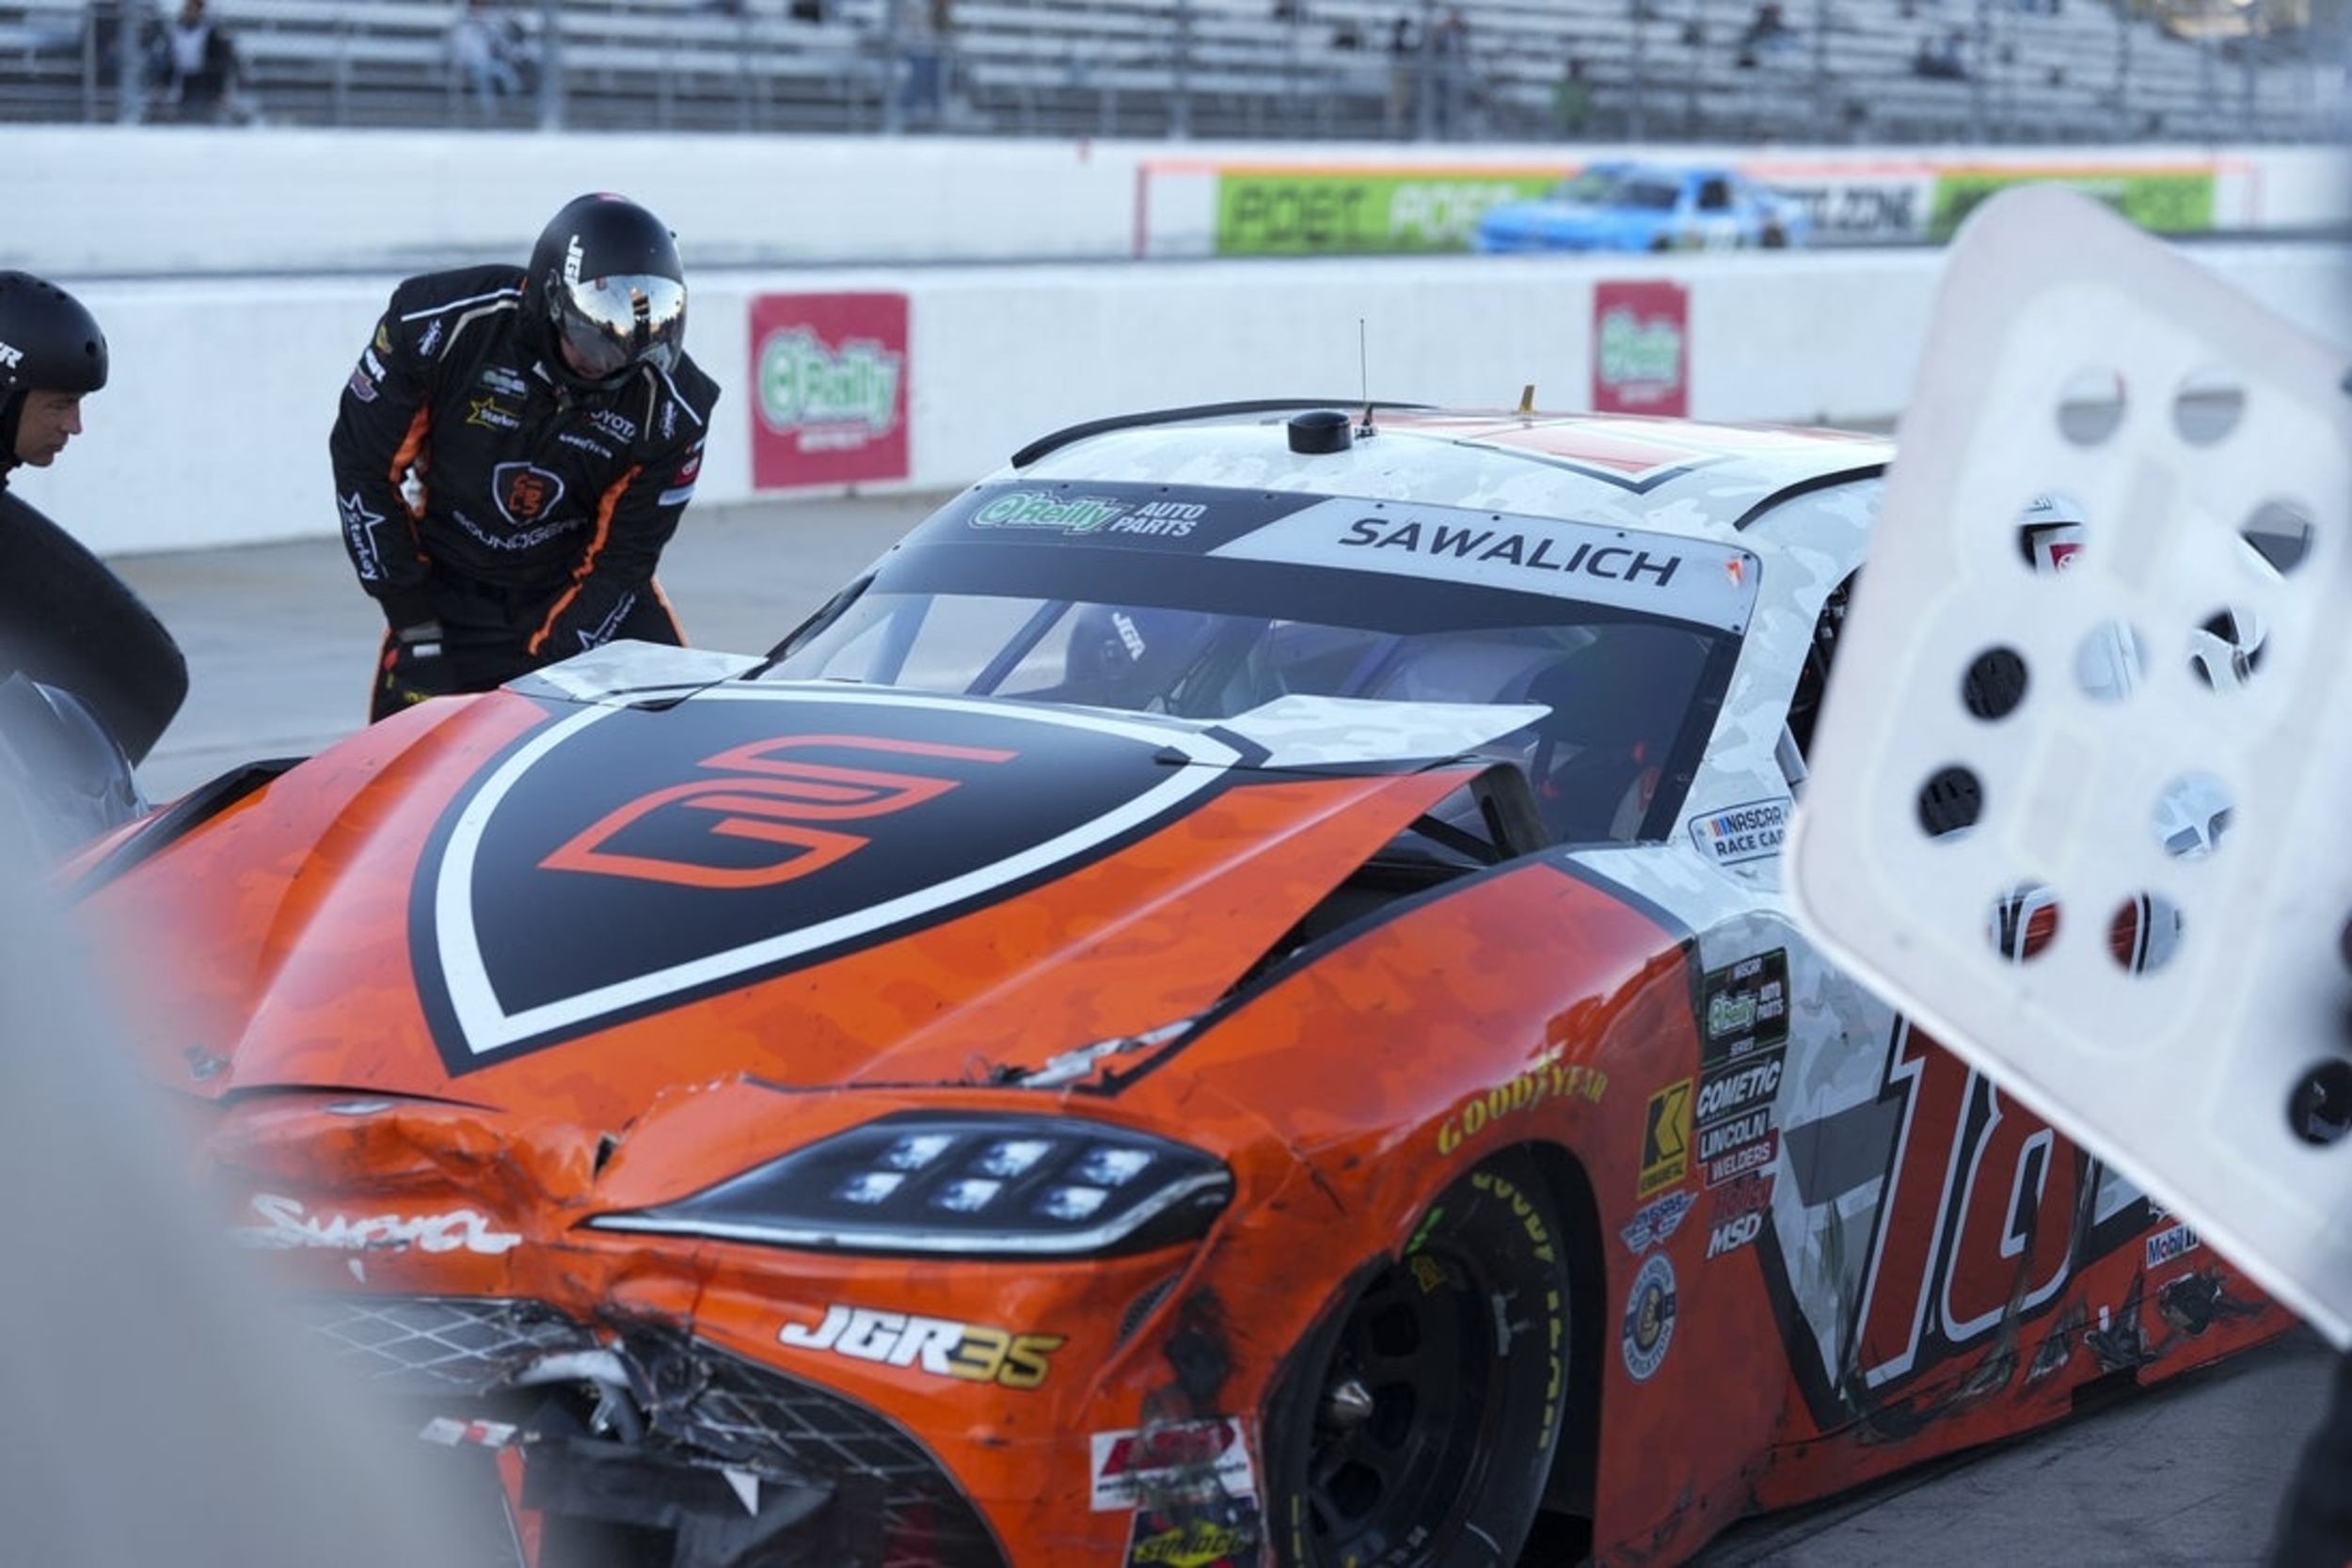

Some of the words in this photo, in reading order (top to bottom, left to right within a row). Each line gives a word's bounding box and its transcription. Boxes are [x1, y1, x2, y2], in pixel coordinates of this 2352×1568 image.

[1109, 516, 1198, 537] PARTS
[1136, 501, 1208, 519] AUTO
[1338, 517, 1682, 588] SAWALICH
[1112, 611, 1146, 661] JGR
[1725, 805, 1785, 836] NASCAR
[1714, 834, 1757, 857] RACE
[1696, 1060, 1782, 1119] COMETIC
[1699, 1112, 1768, 1161] LINCOLN
[1710, 1142, 1771, 1180] WELDERS
[1706, 1211, 1763, 1259] MSD
